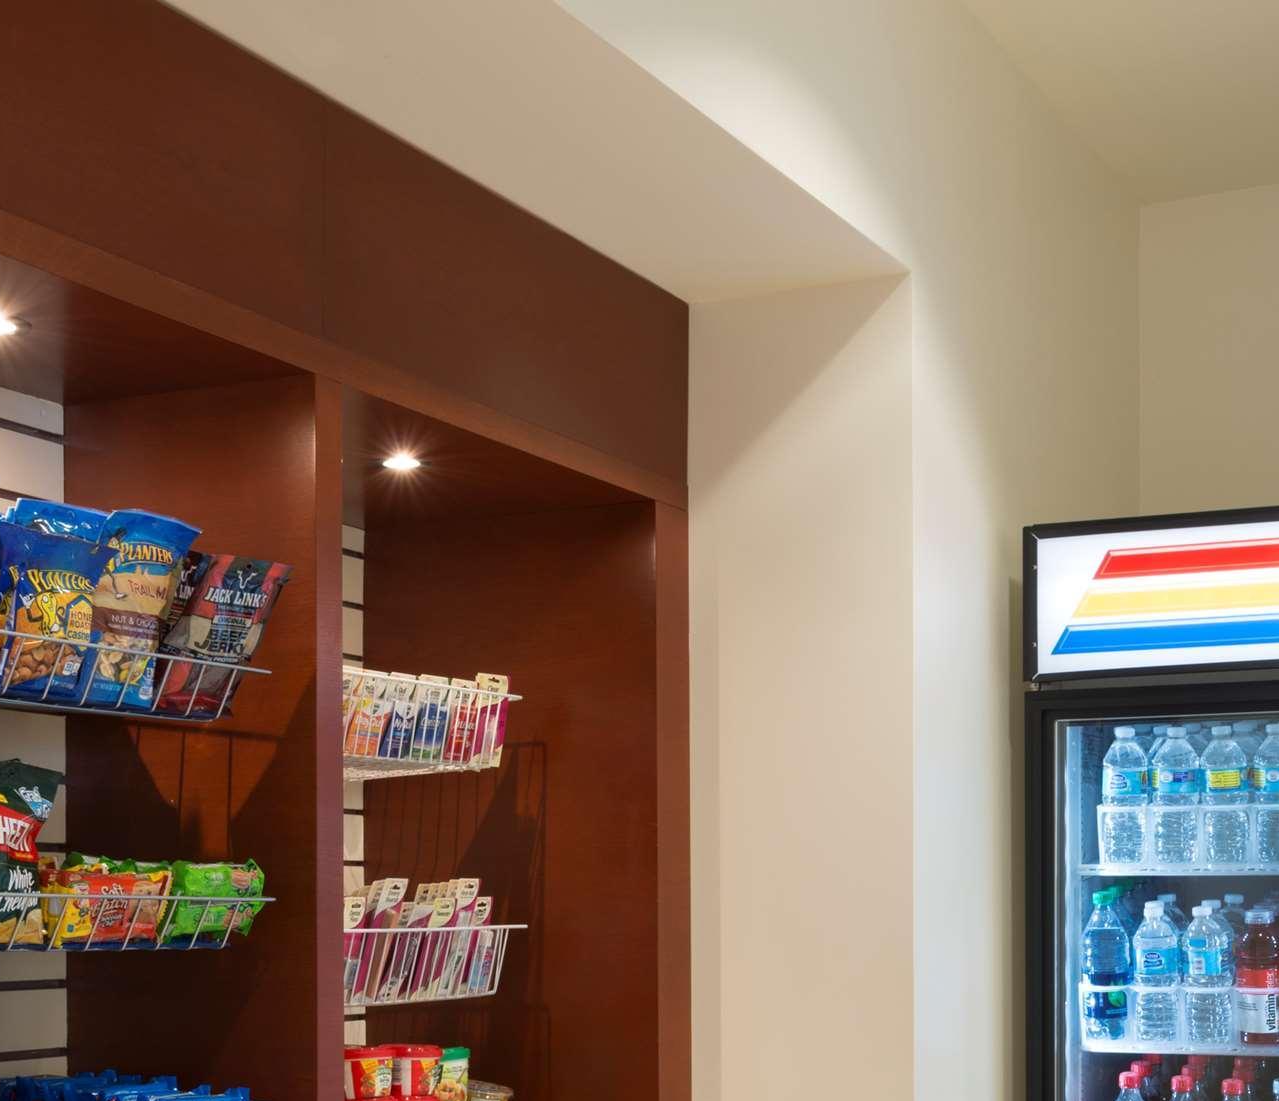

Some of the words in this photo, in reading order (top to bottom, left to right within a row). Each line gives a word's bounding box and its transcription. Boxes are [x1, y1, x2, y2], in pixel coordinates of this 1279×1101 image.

[120, 541, 173, 565] PLANTERS
[27, 569, 96, 593] PLANTERS
[128, 579, 155, 598] TRAIL
[204, 585, 232, 602] JACK
[8, 864, 36, 891] White
